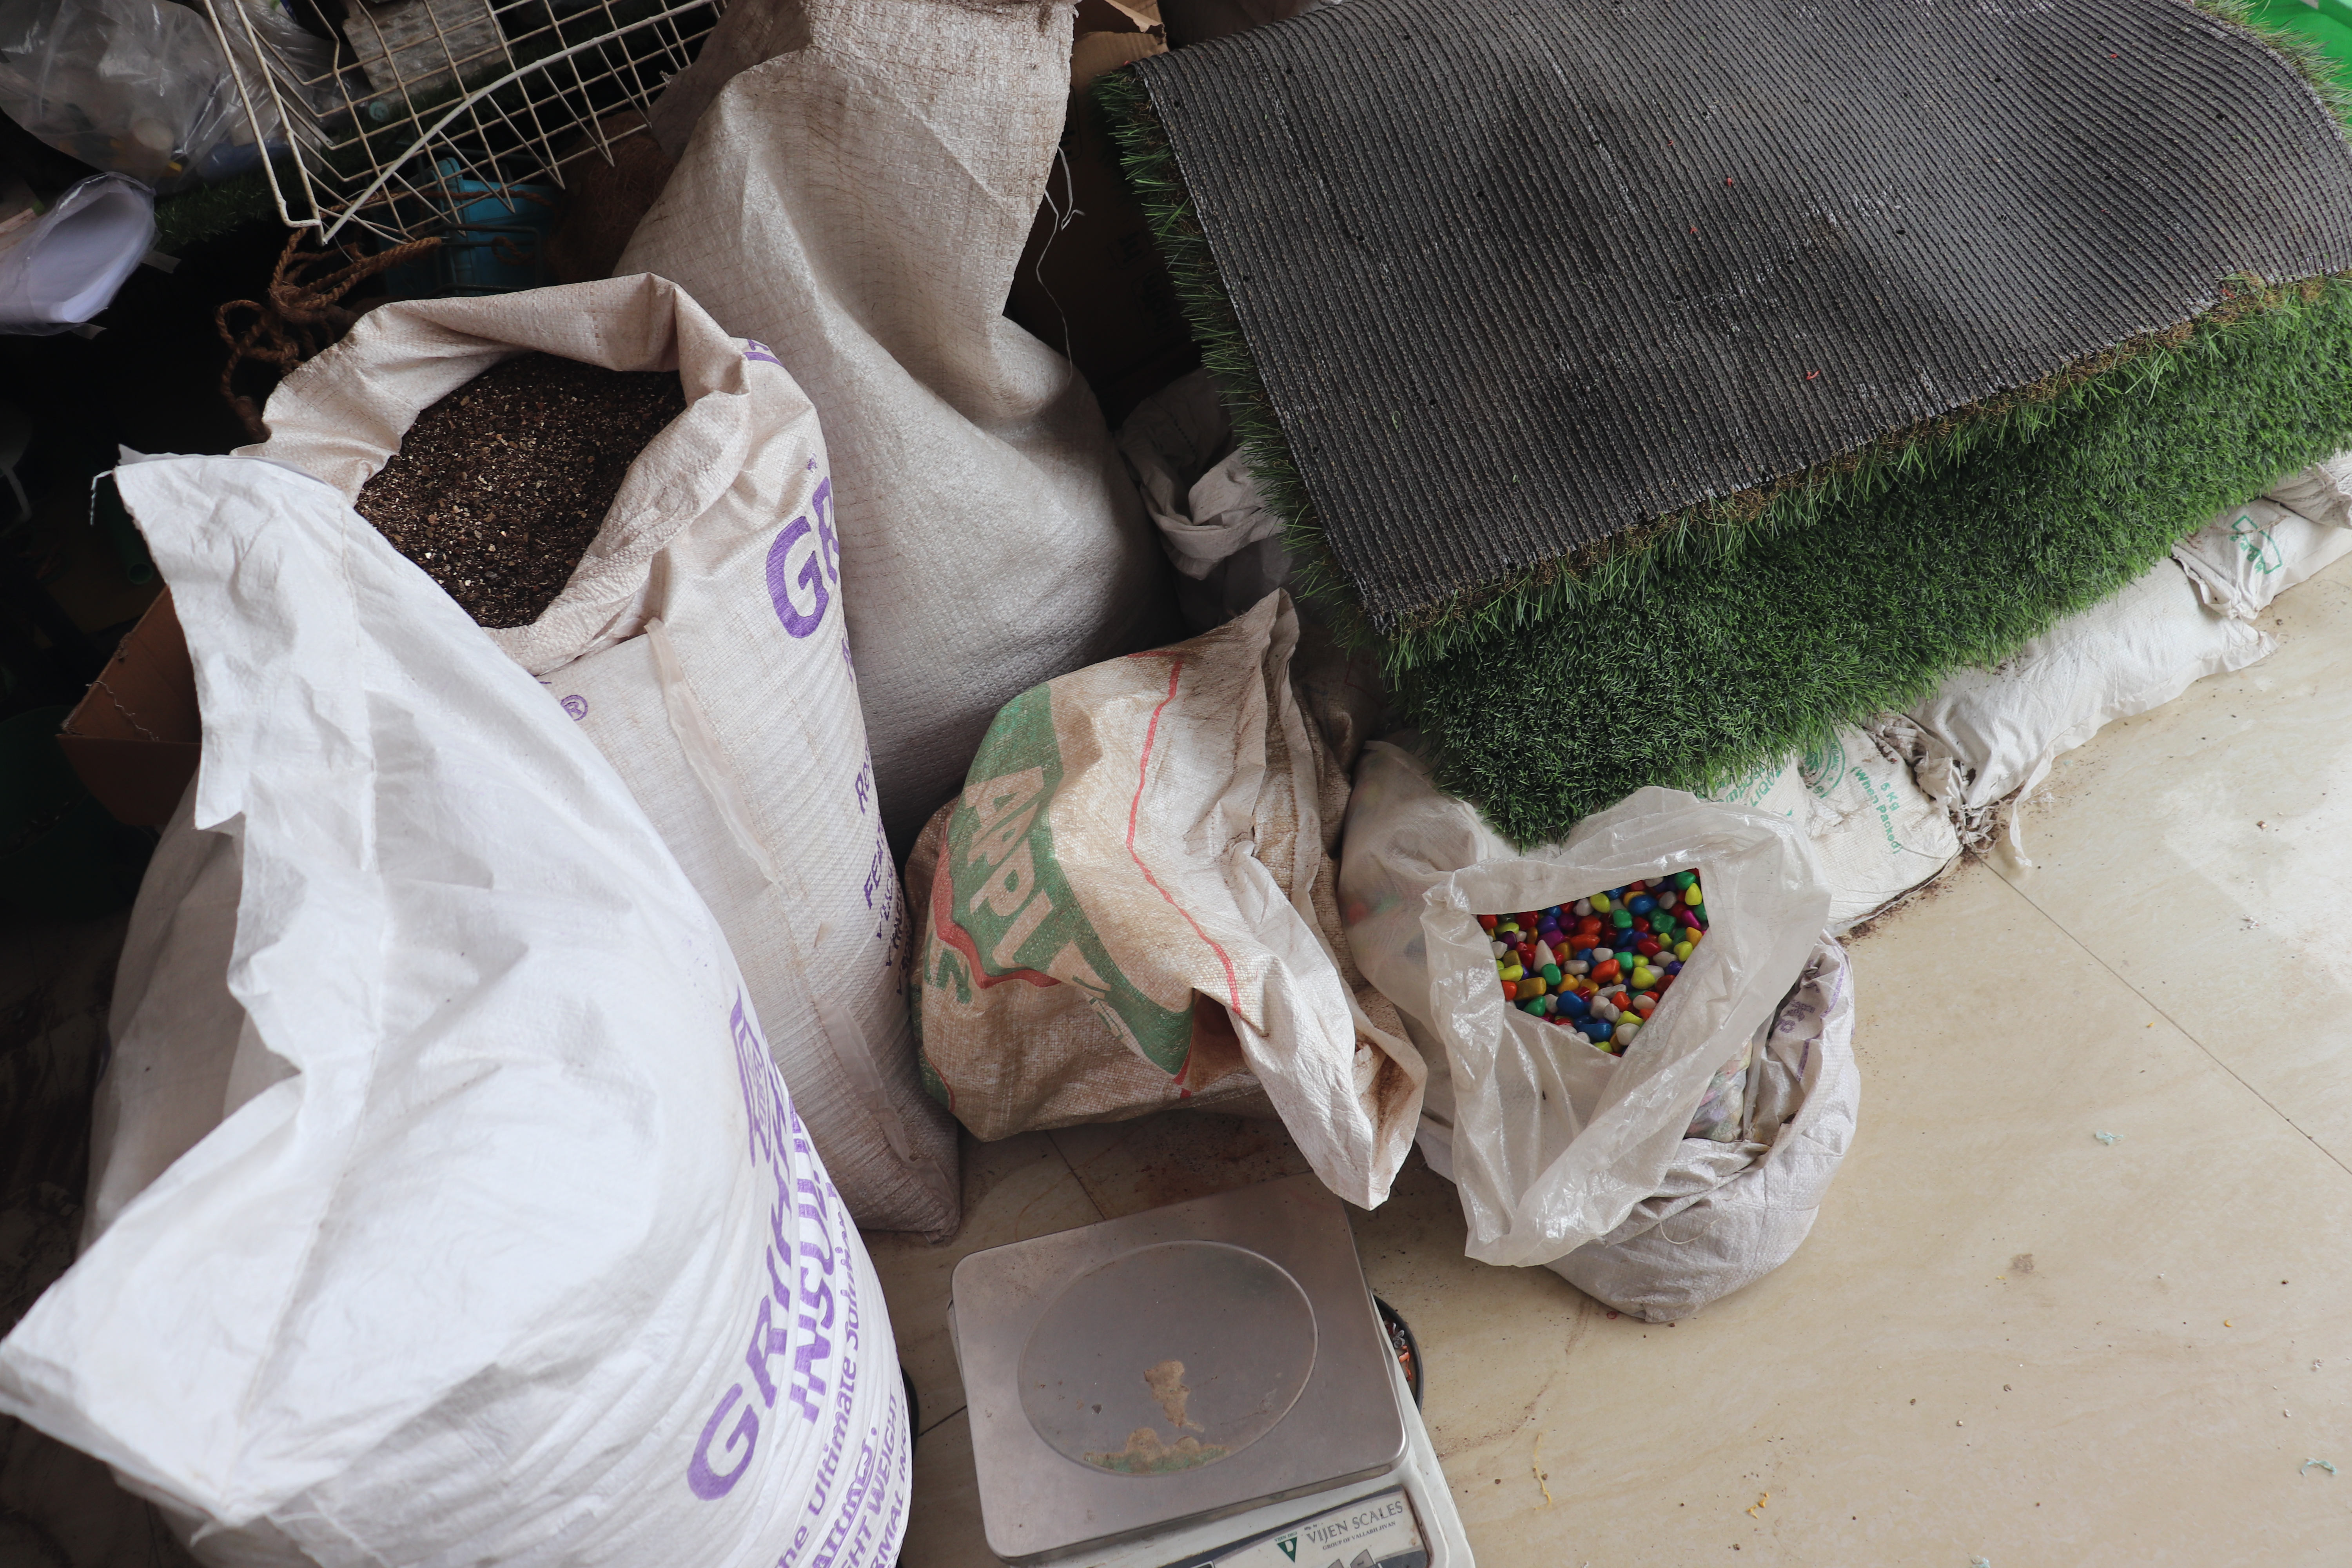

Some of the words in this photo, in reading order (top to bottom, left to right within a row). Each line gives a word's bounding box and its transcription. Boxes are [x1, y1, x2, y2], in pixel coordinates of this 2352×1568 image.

[808, 1356, 857, 1516] Ultimate
[867, 1383, 897, 1515] WEIGHT
[1307, 1521, 1348, 1543] VIJEN
[1352, 1501, 1403, 1529] SCALES
[1323, 1540, 1342, 1550] GROUP
[1379, 1521, 1396, 1530] JIVAN
